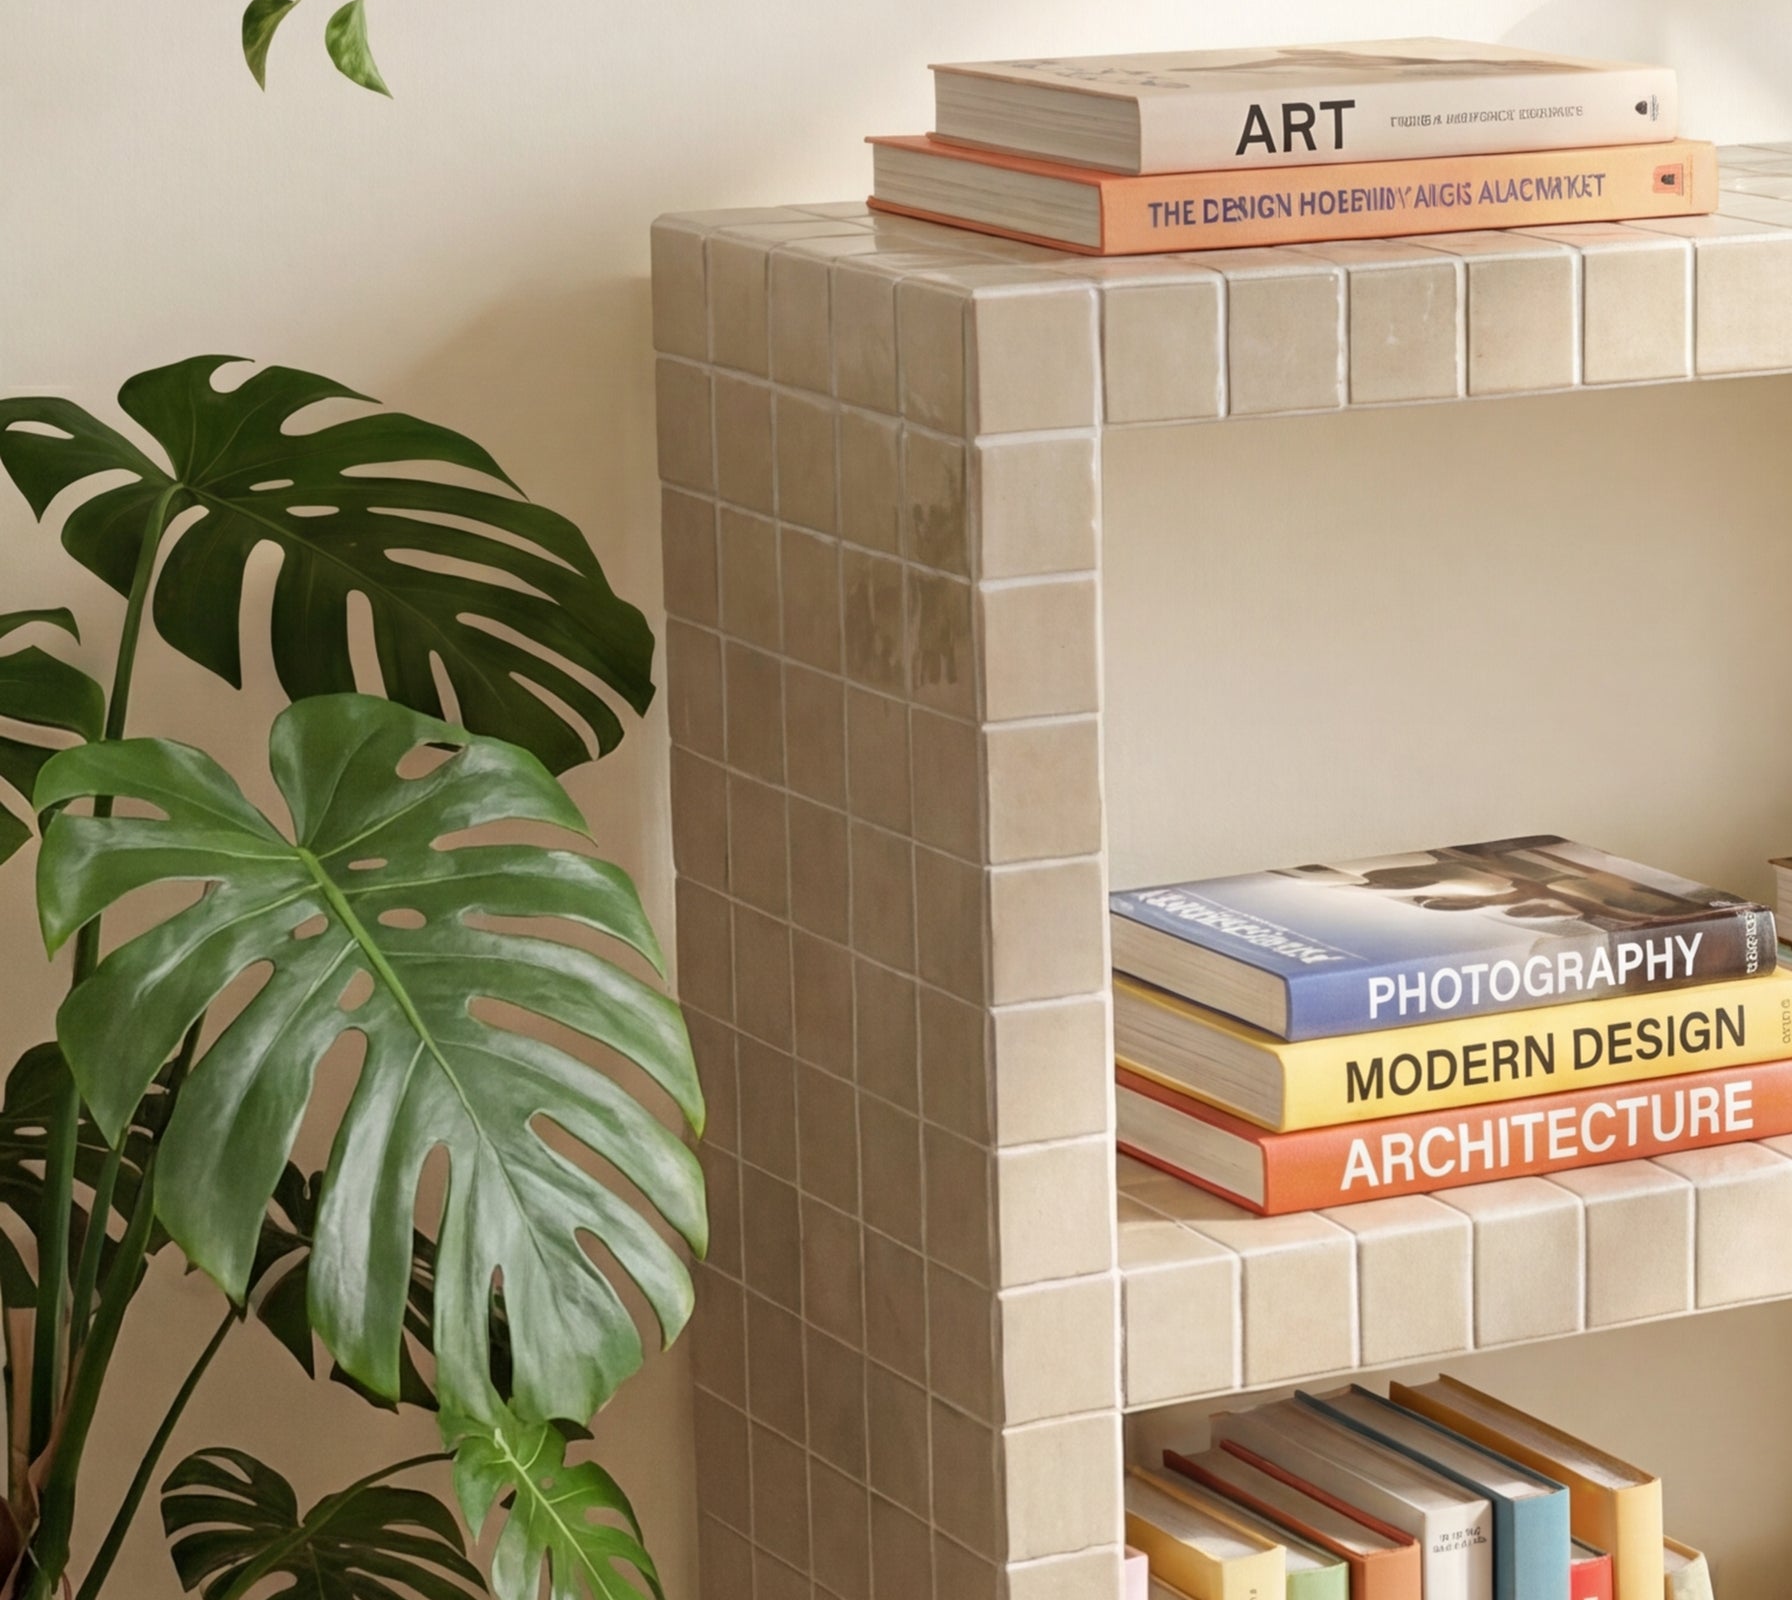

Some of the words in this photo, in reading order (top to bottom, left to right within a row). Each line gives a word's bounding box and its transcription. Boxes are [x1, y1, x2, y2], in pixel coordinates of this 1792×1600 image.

[1234, 99, 1356, 156] ART
[1148, 200, 1196, 228] THE
[1367, 932, 1703, 1019] PHOTOGRAPHY
[1346, 1032, 1555, 1103] MODERN
[1572, 1005, 1746, 1068] DESIGN
[1341, 1081, 1754, 1191] ARCHITECTURE
